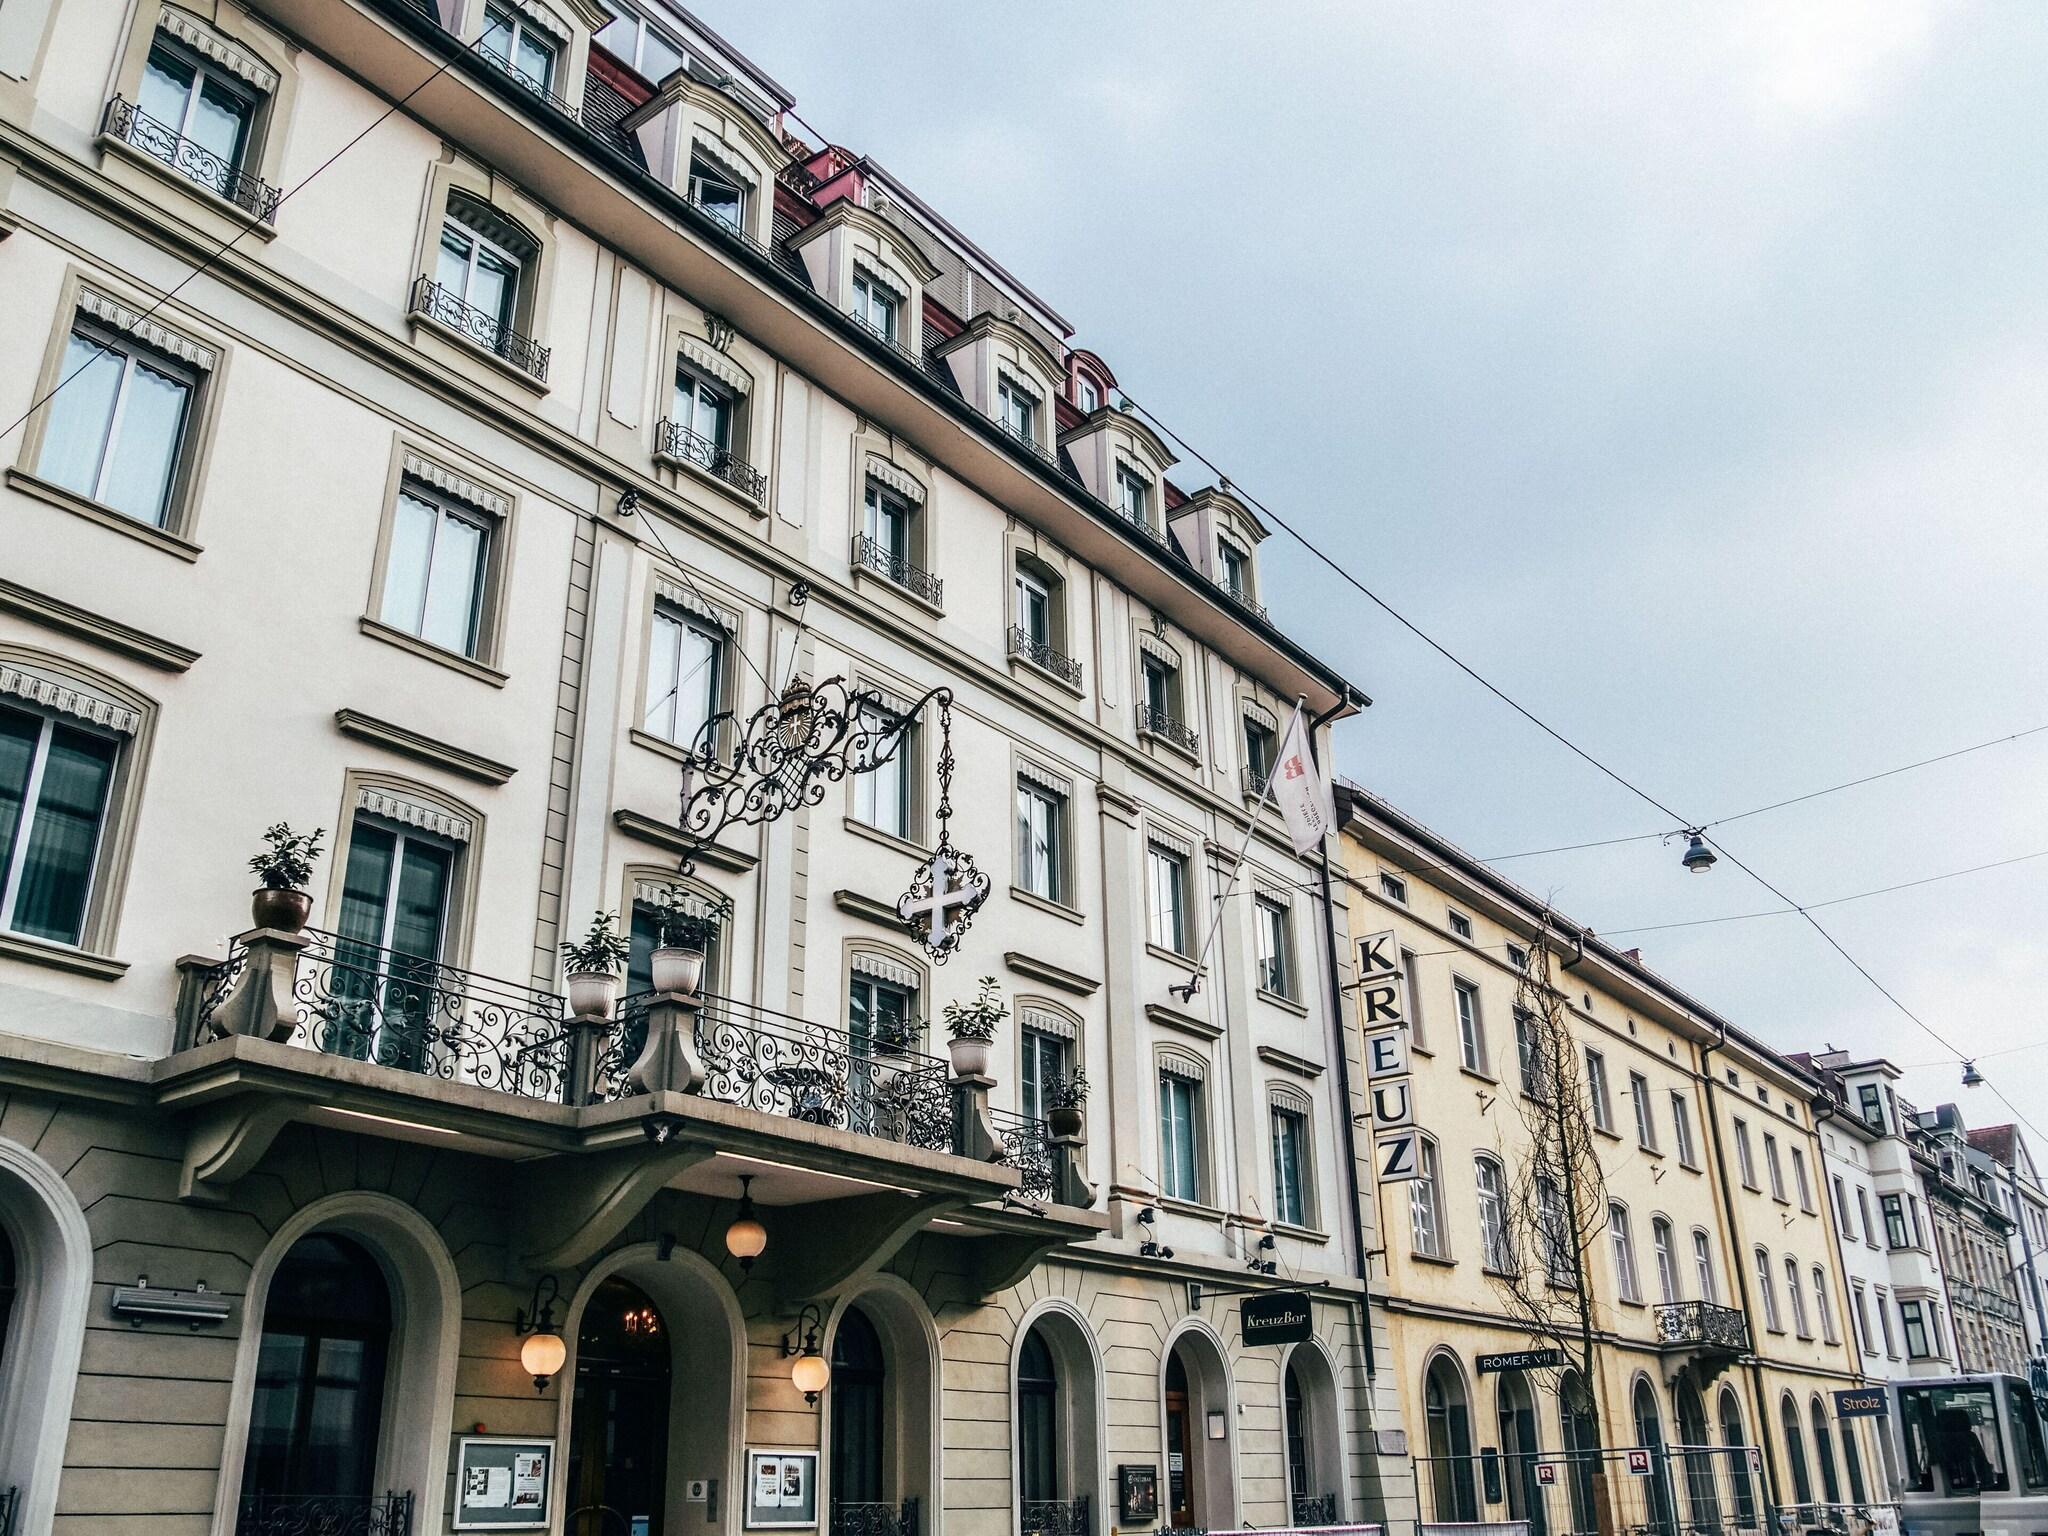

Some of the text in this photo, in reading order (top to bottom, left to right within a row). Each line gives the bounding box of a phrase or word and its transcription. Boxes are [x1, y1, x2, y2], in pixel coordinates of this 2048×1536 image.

[1358, 937, 1413, 1176] KREUZ
[1247, 1311, 1306, 1327] KreuzBar
[1483, 1356, 1530, 1369] RÖMER
[1842, 1396, 1880, 1410] Strolz
[1631, 1454, 1646, 1466] R
